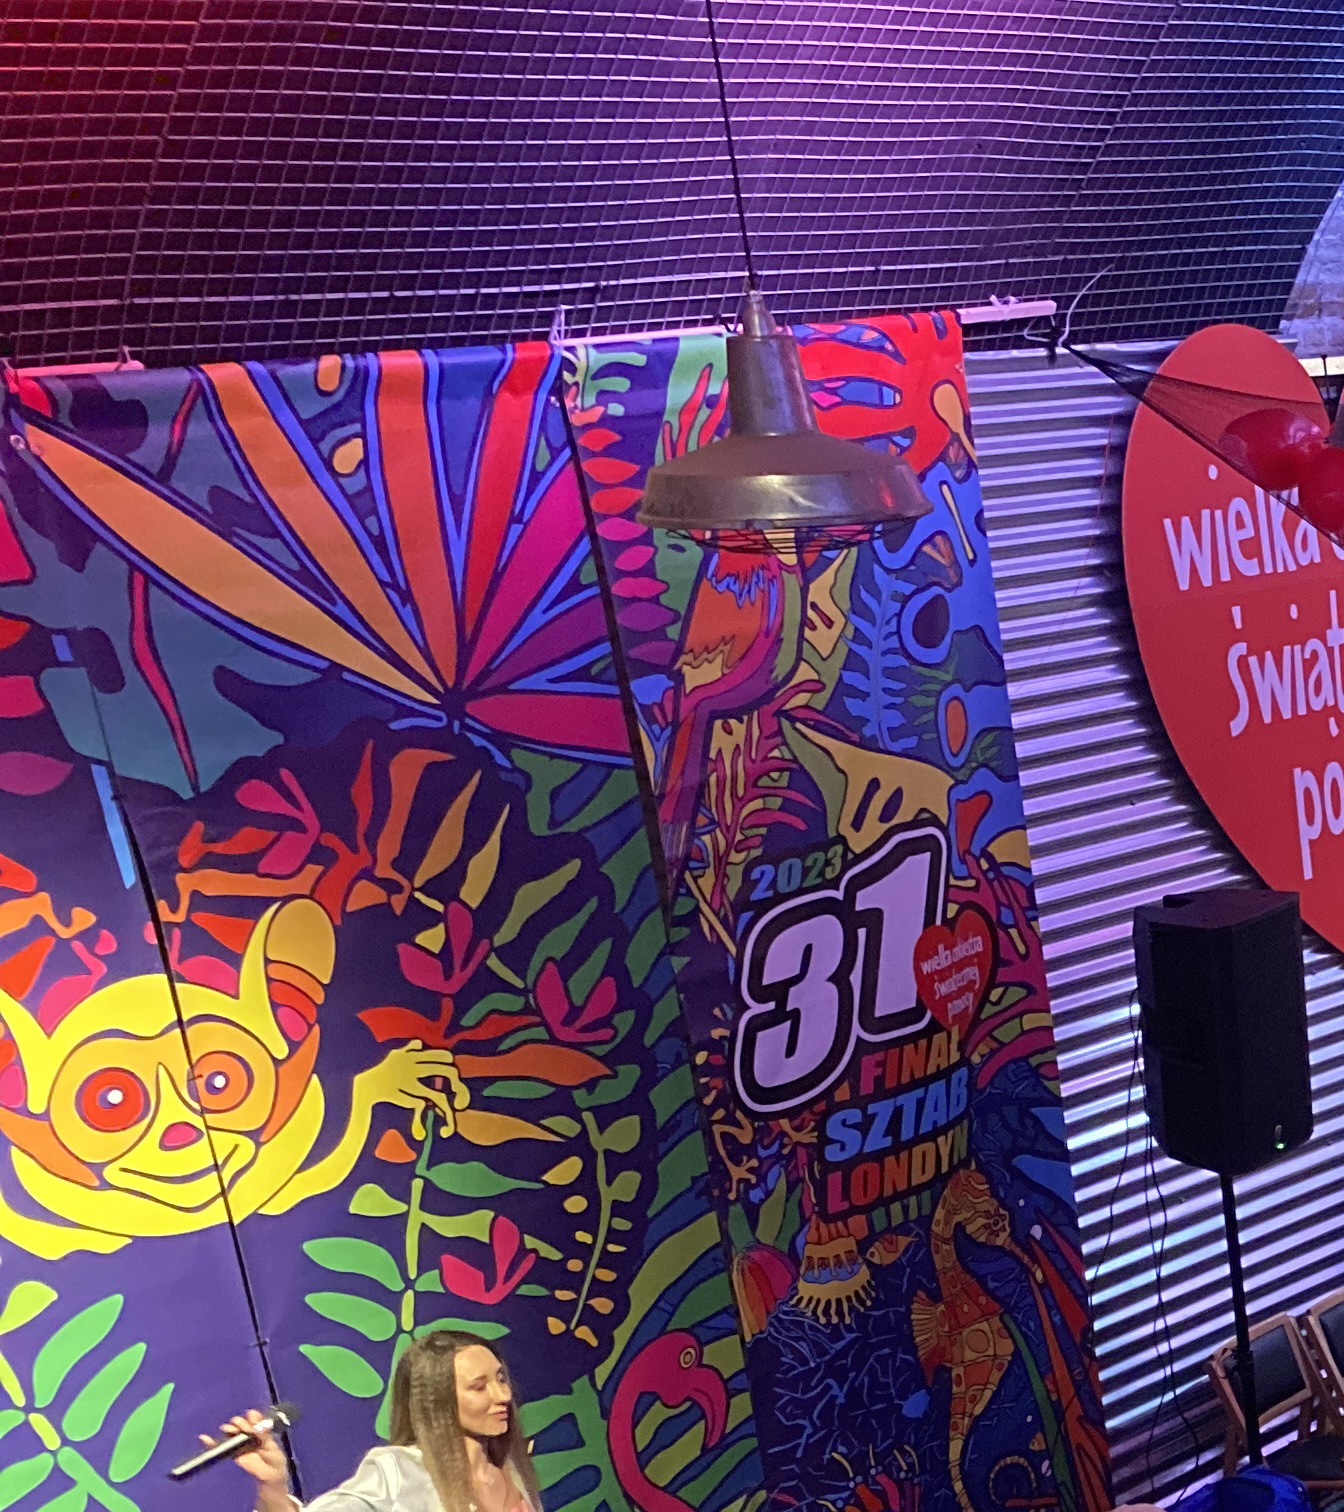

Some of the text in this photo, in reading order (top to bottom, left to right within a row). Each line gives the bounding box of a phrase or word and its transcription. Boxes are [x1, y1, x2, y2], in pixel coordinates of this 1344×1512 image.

[1163, 464, 1320, 590] wielka
[750, 844, 844, 902] 2023
[741, 836, 942, 1105] 31
[859, 1024, 961, 1096] FINAŁ
[823, 1067, 969, 1163] SZTAB
[826, 1119, 969, 1215] LONDYN
